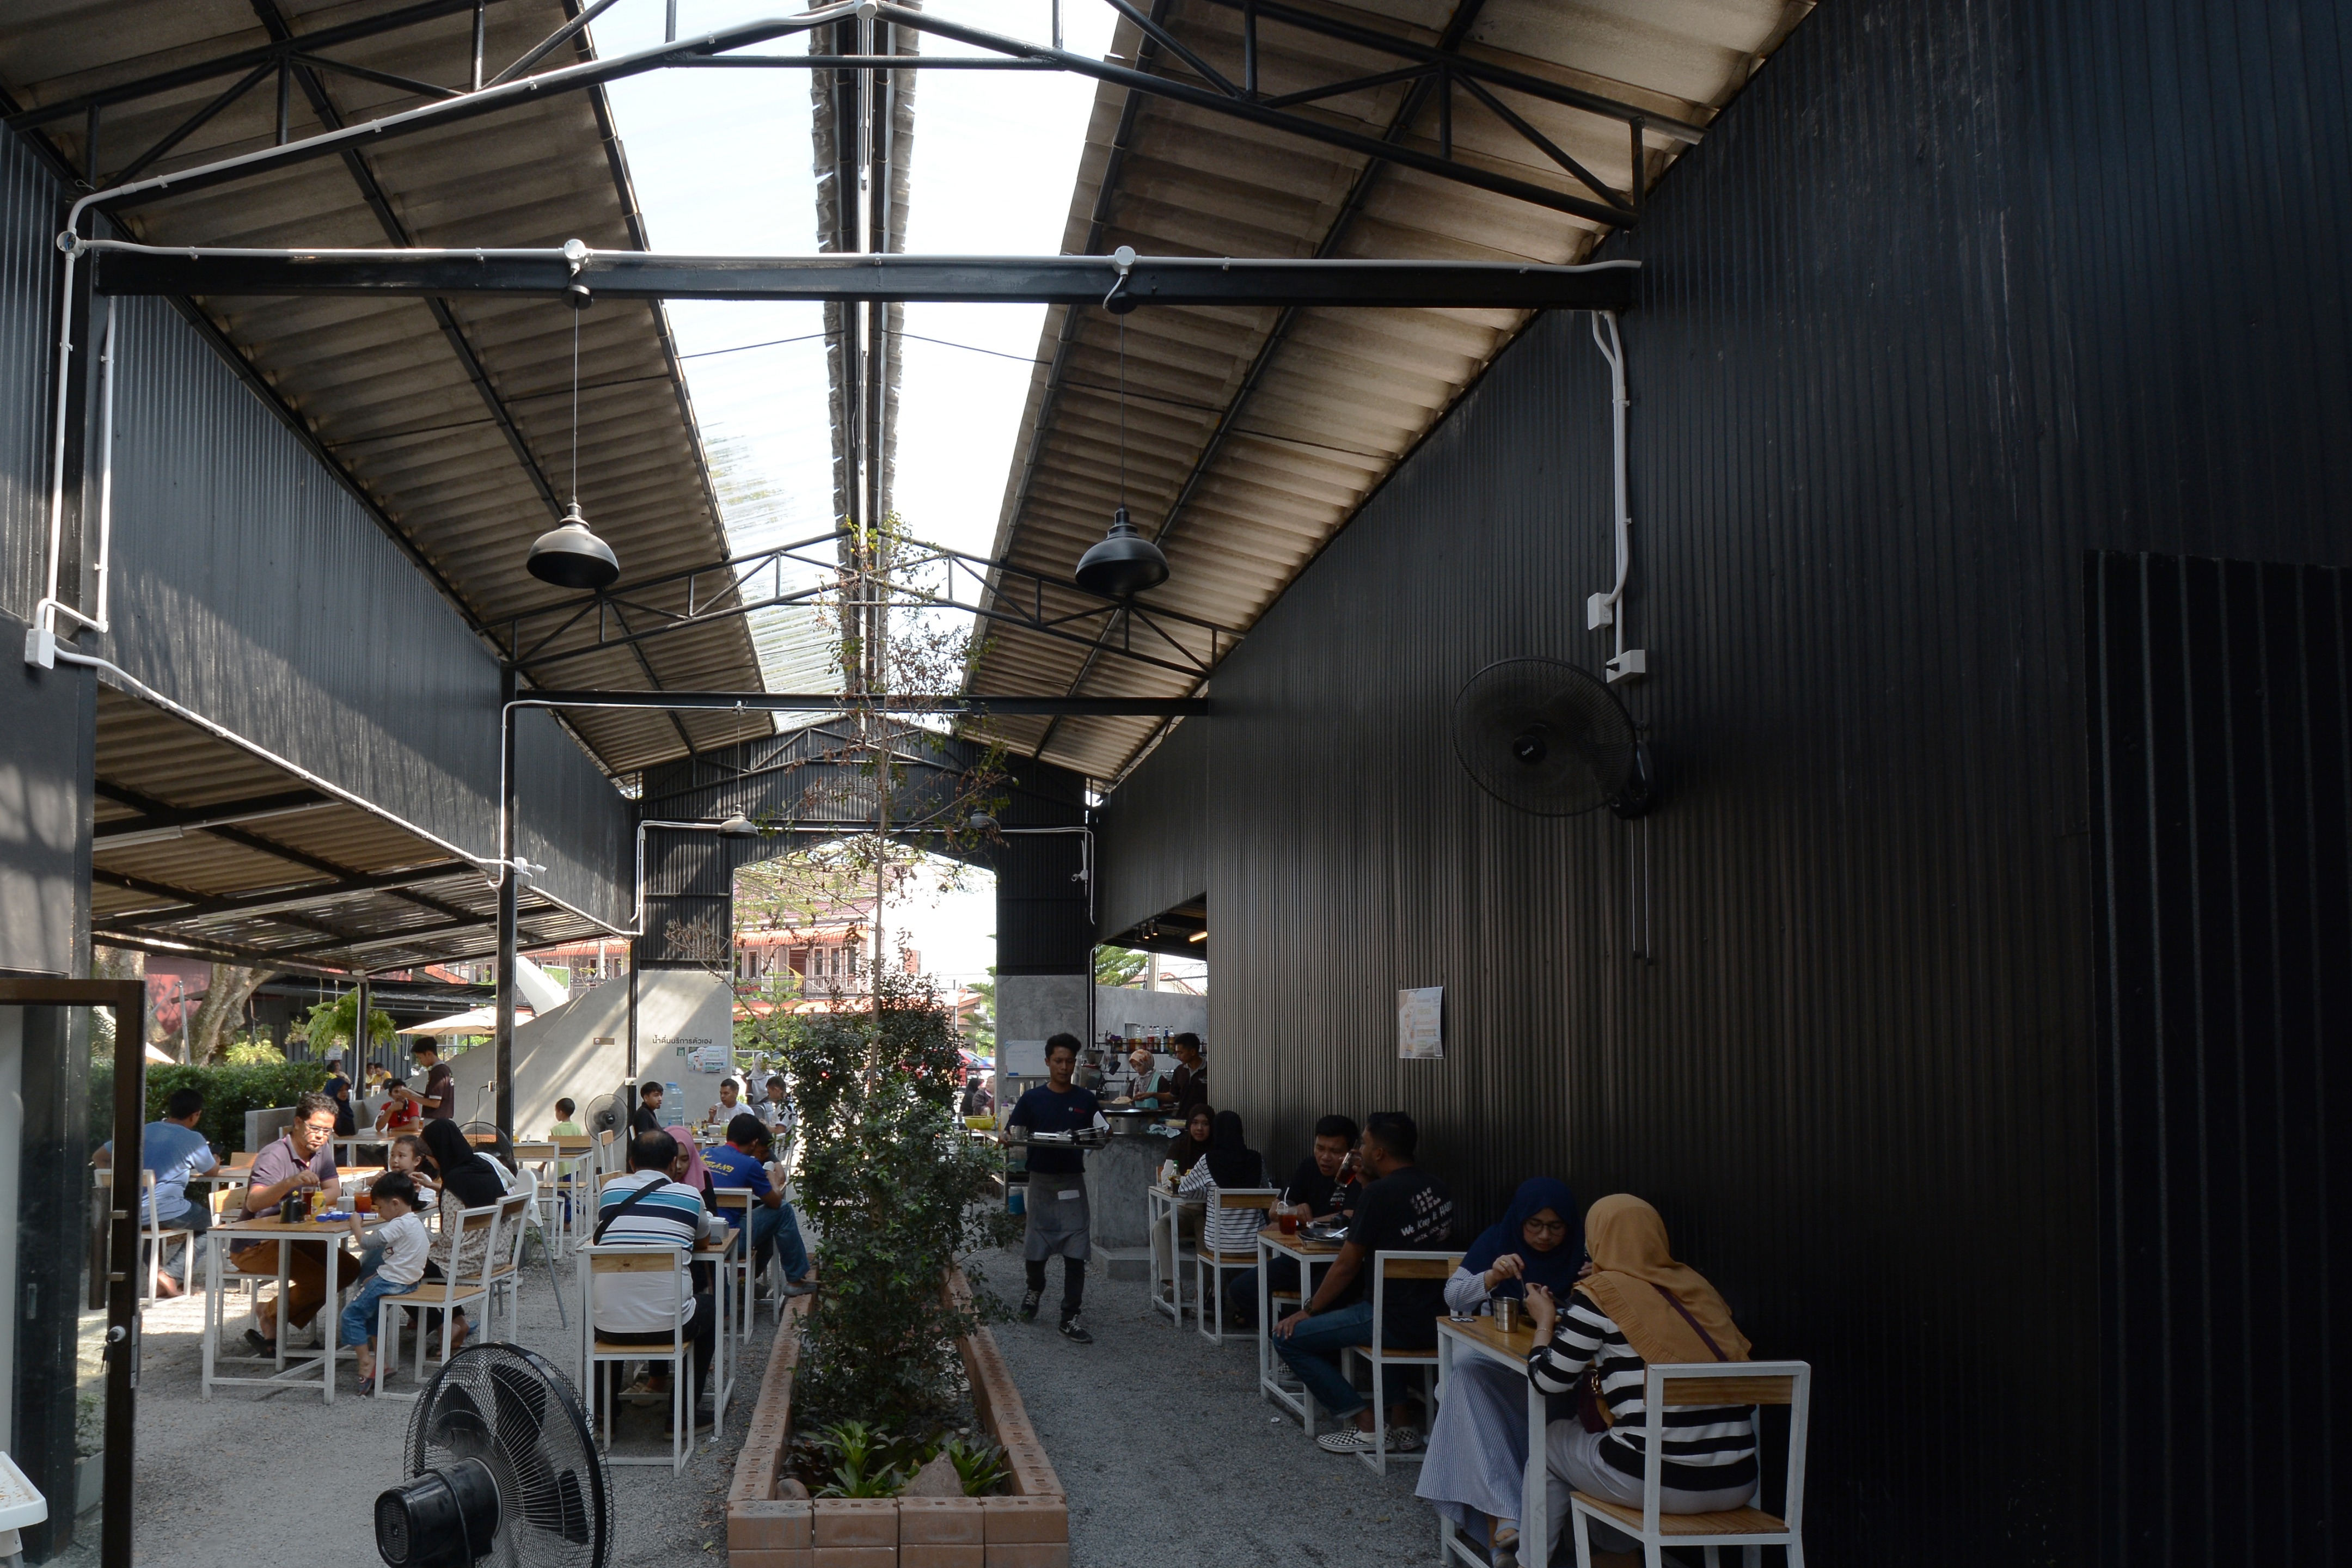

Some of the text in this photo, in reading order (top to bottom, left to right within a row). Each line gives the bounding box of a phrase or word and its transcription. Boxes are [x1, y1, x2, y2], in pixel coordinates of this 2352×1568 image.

[652, 1034, 712, 1044] น้ำดื่มบริการตัวเอง
[1400, 1224, 1415, 1236] We
